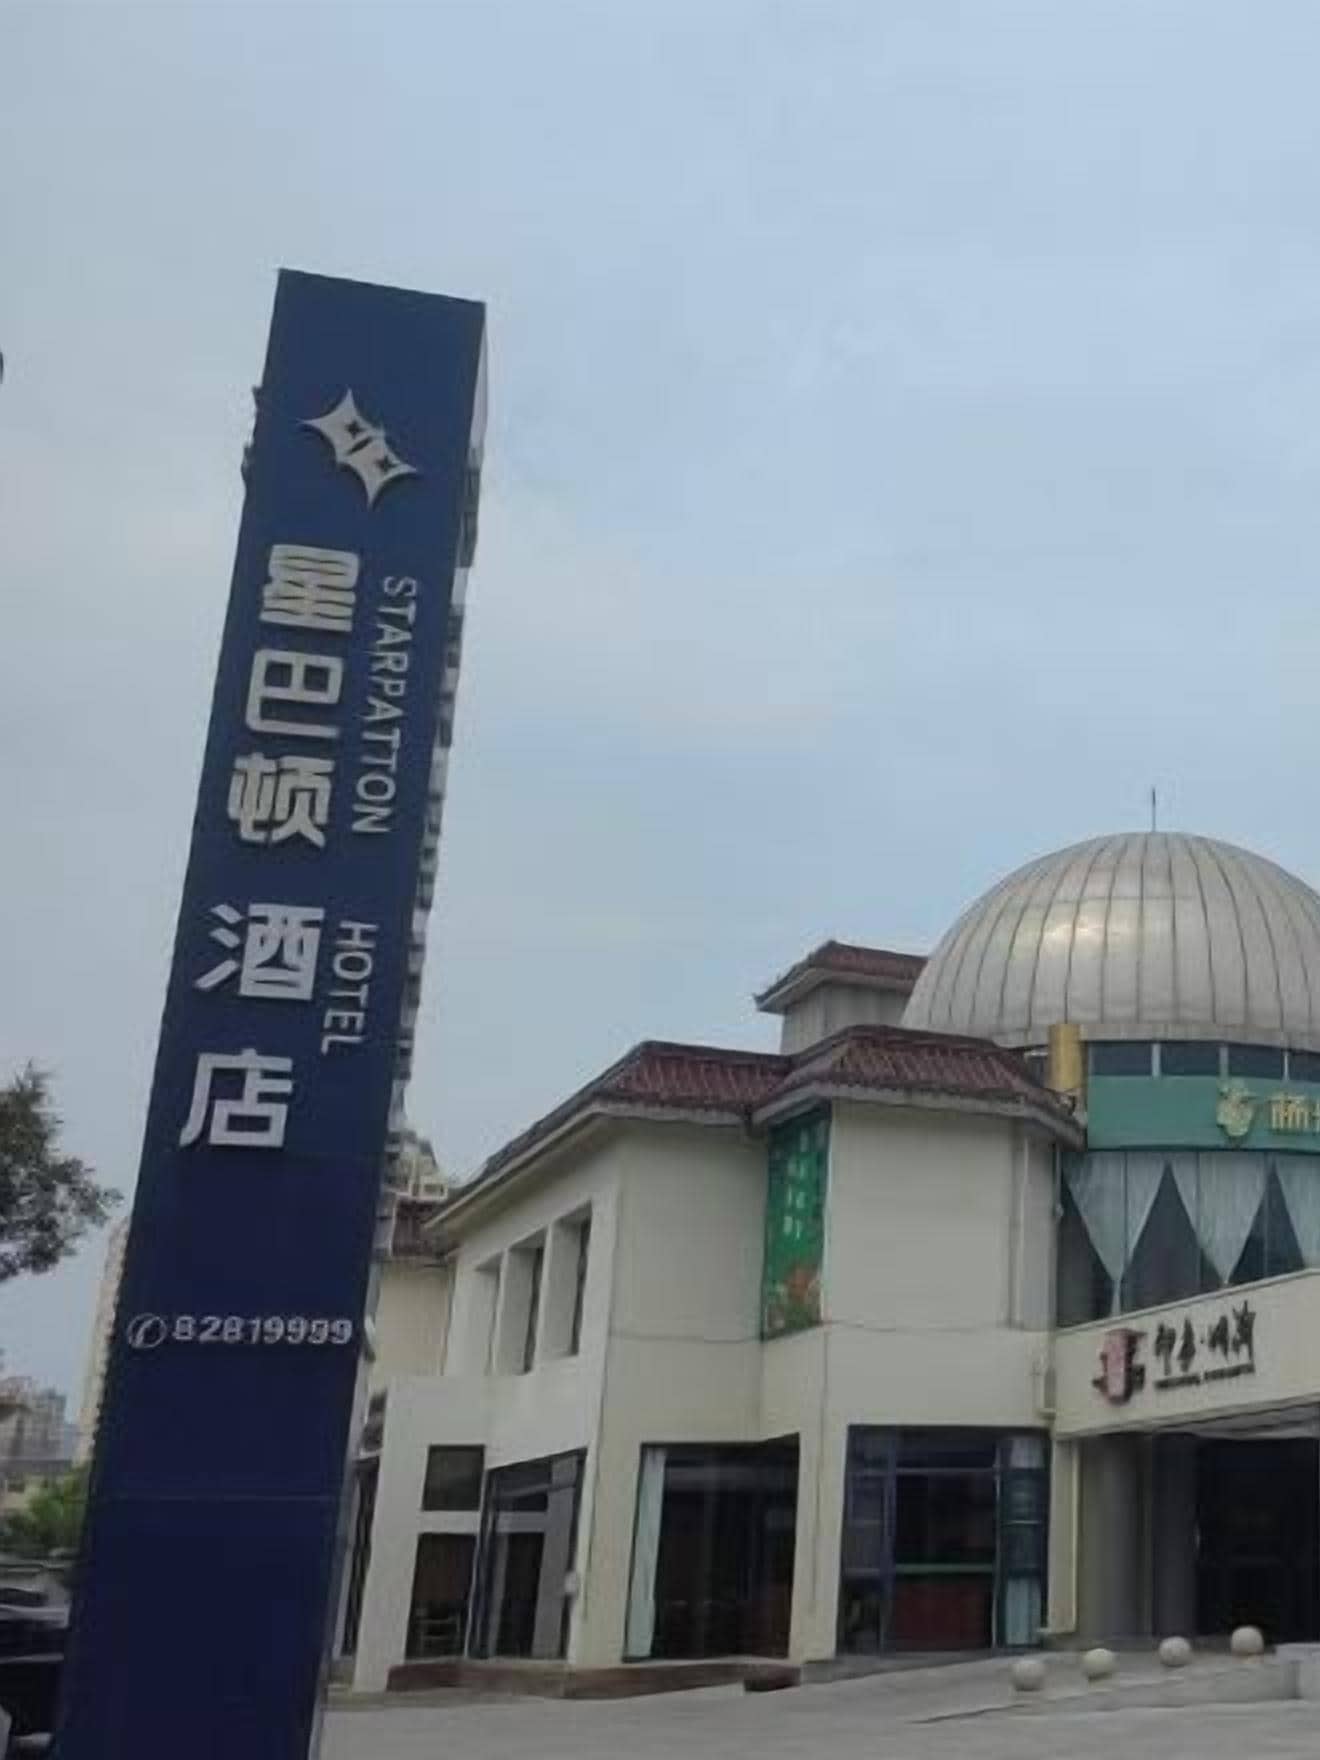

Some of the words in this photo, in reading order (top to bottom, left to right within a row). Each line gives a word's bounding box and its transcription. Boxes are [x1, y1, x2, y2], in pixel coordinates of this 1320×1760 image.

[350, 575, 417, 834] STARPATTON
[180, 544, 360, 1148] 星巴顿酒店
[320, 919, 380, 1056] HOTEL
[172, 1314, 353, 1345] 82819999
